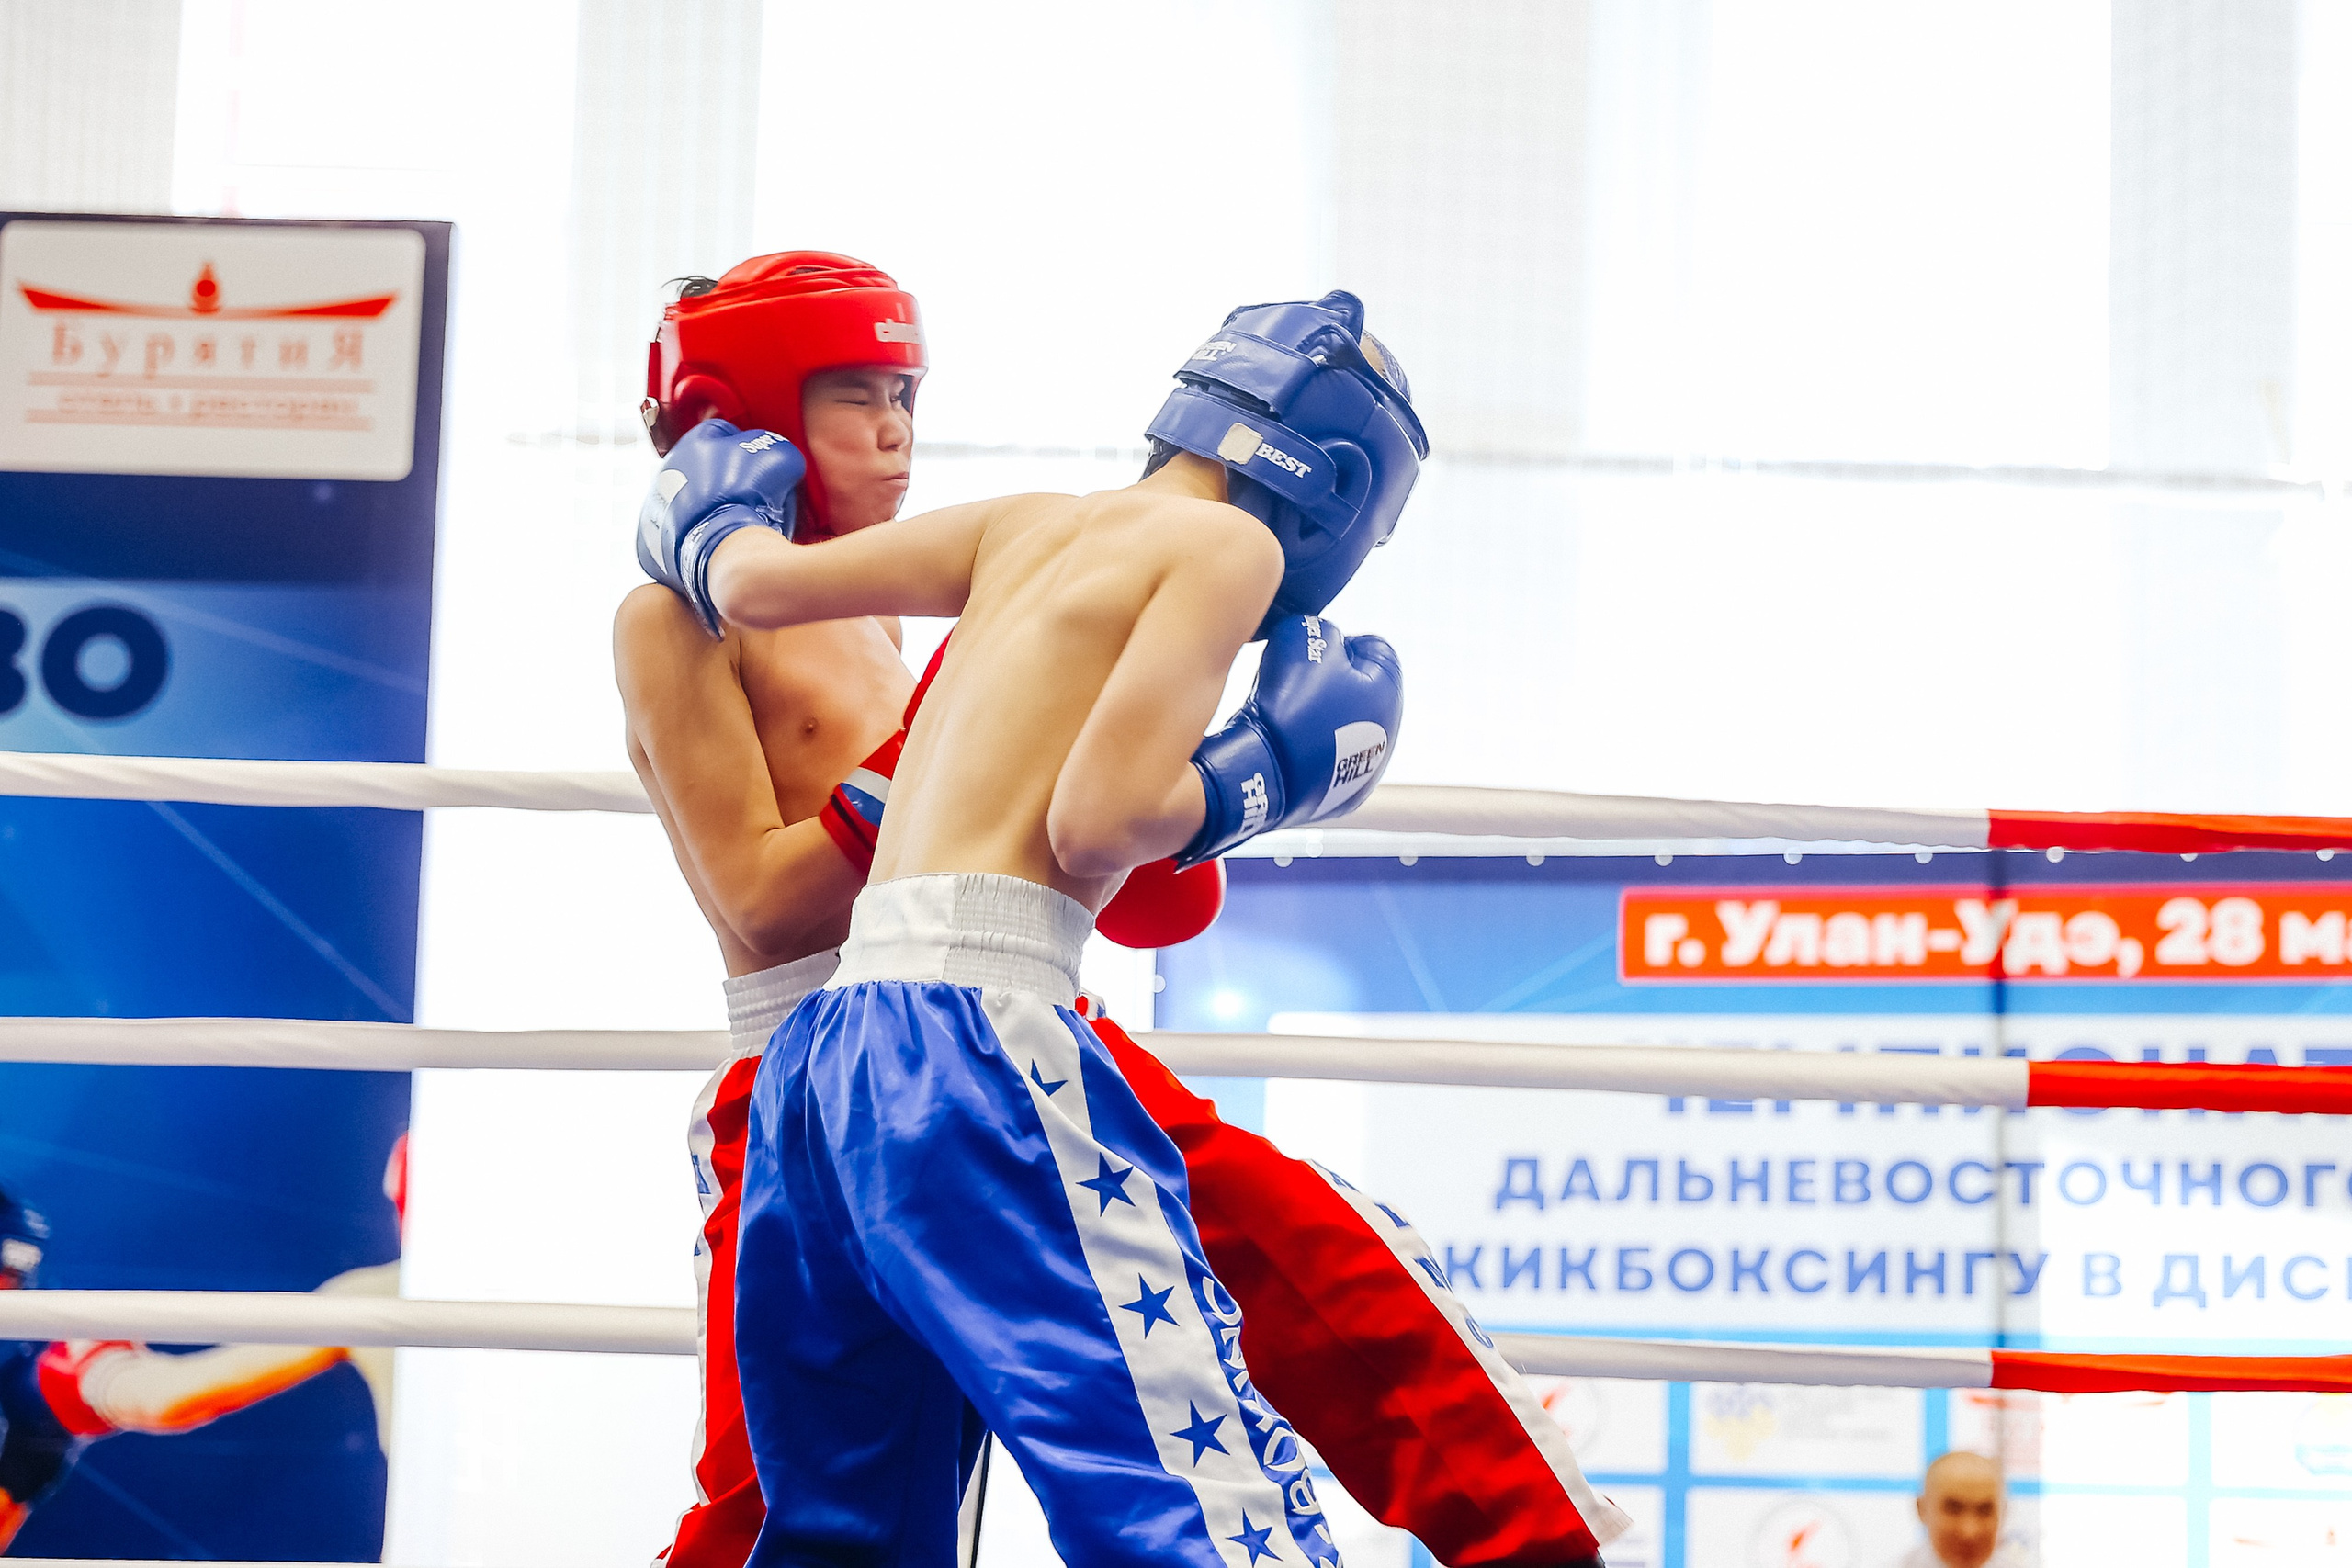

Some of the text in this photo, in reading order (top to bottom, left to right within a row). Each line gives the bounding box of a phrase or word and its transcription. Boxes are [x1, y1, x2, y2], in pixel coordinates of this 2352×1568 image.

[1255, 442, 1313, 479] BEST
[1332, 758, 1374, 788] HILL
[1336, 740, 1386, 773] GREEN
[1644, 897, 2352, 979] г. Улан-Удэ, 28 м
[1496, 1158, 2352, 1210] ДАЛЬНЕВОСТОЧНОГ
[1447, 1246, 2352, 1309] КИКБОКСИНГУ В ДИС
